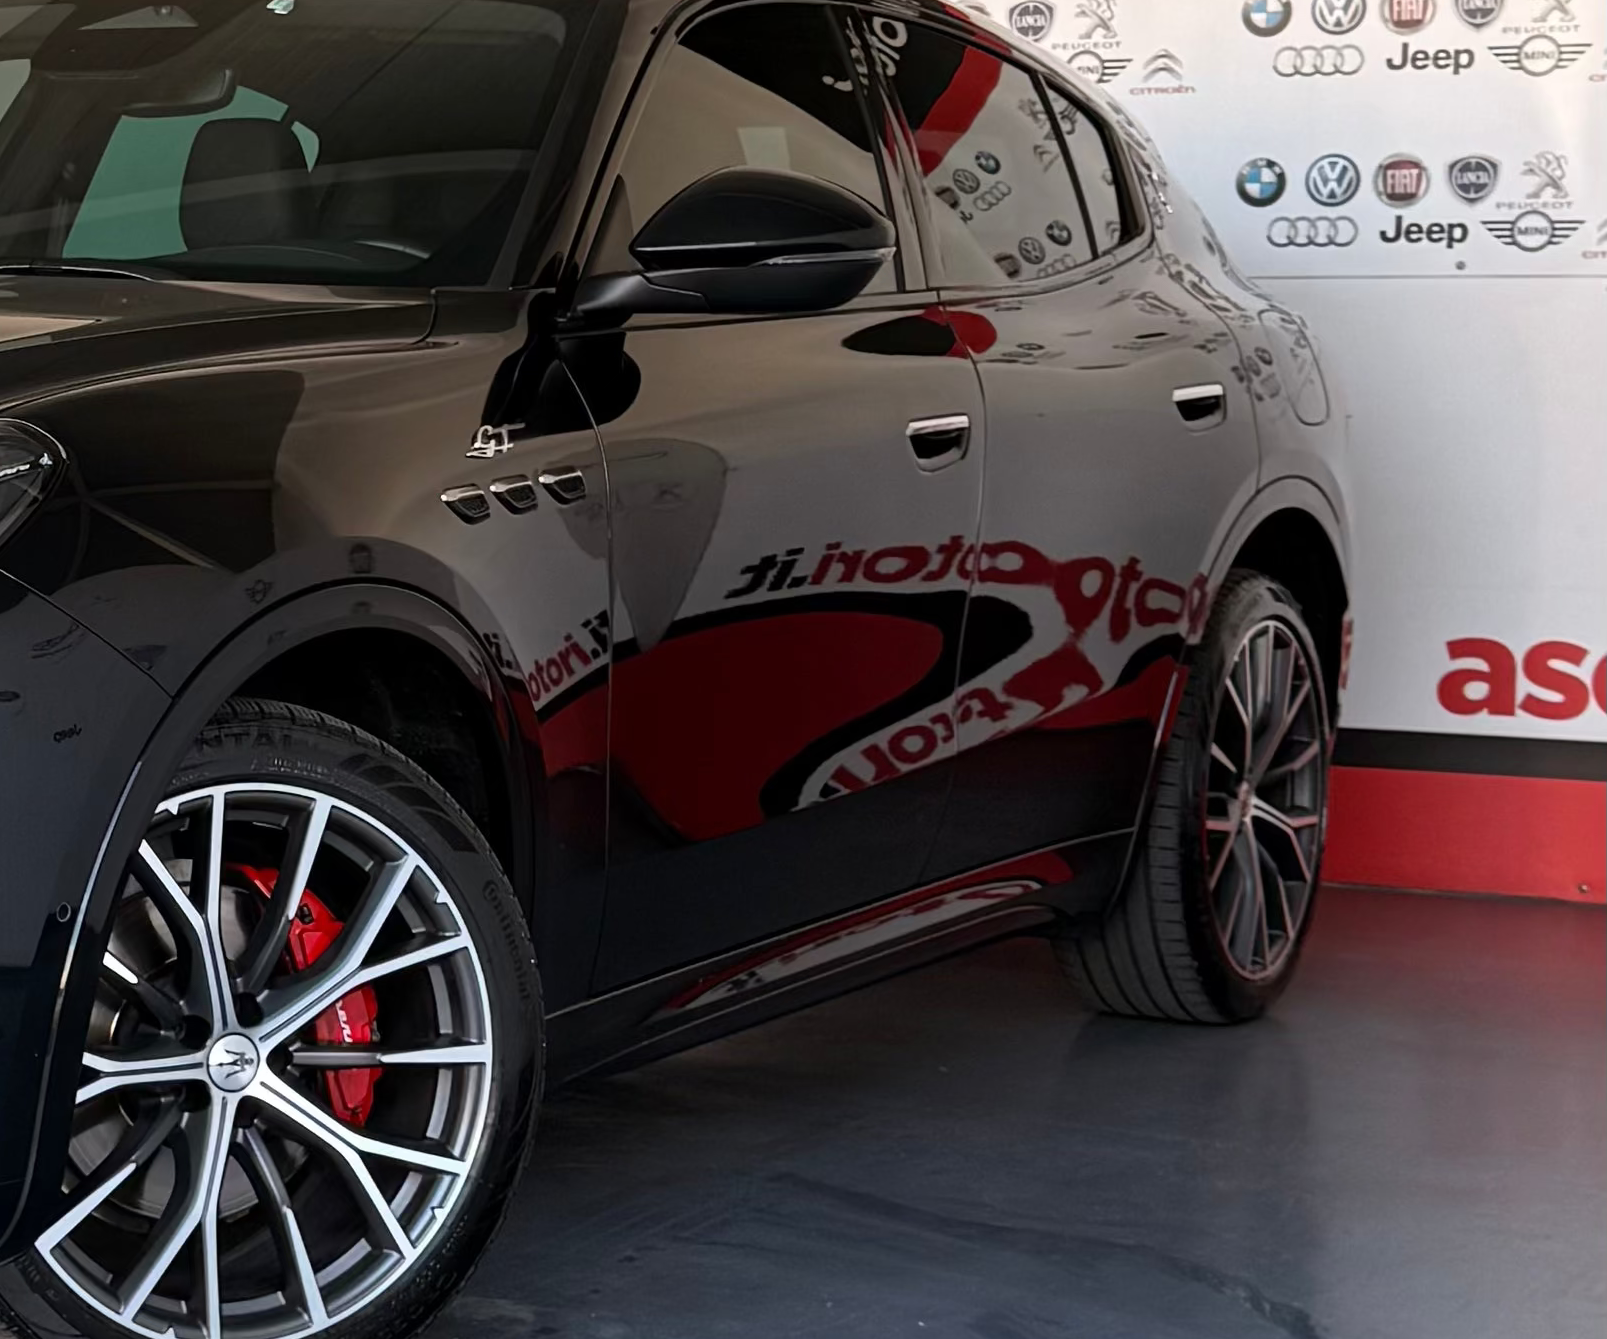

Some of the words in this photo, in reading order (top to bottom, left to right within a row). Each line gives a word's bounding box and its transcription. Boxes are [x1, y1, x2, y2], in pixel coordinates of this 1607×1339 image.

[1501, 23, 1582, 35] PEUGEOT
[1050, 40, 1123, 50] PEUGEOT
[1386, 42, 1475, 75] Jeep
[1523, 49, 1555, 61] MINI
[1386, 168, 1420, 194] FIAT
[1495, 201, 1575, 211] PEUGEOT
[1379, 215, 1469, 249] Jeep
[1516, 225, 1550, 237] MINI
[1436, 637, 1607, 721] as
